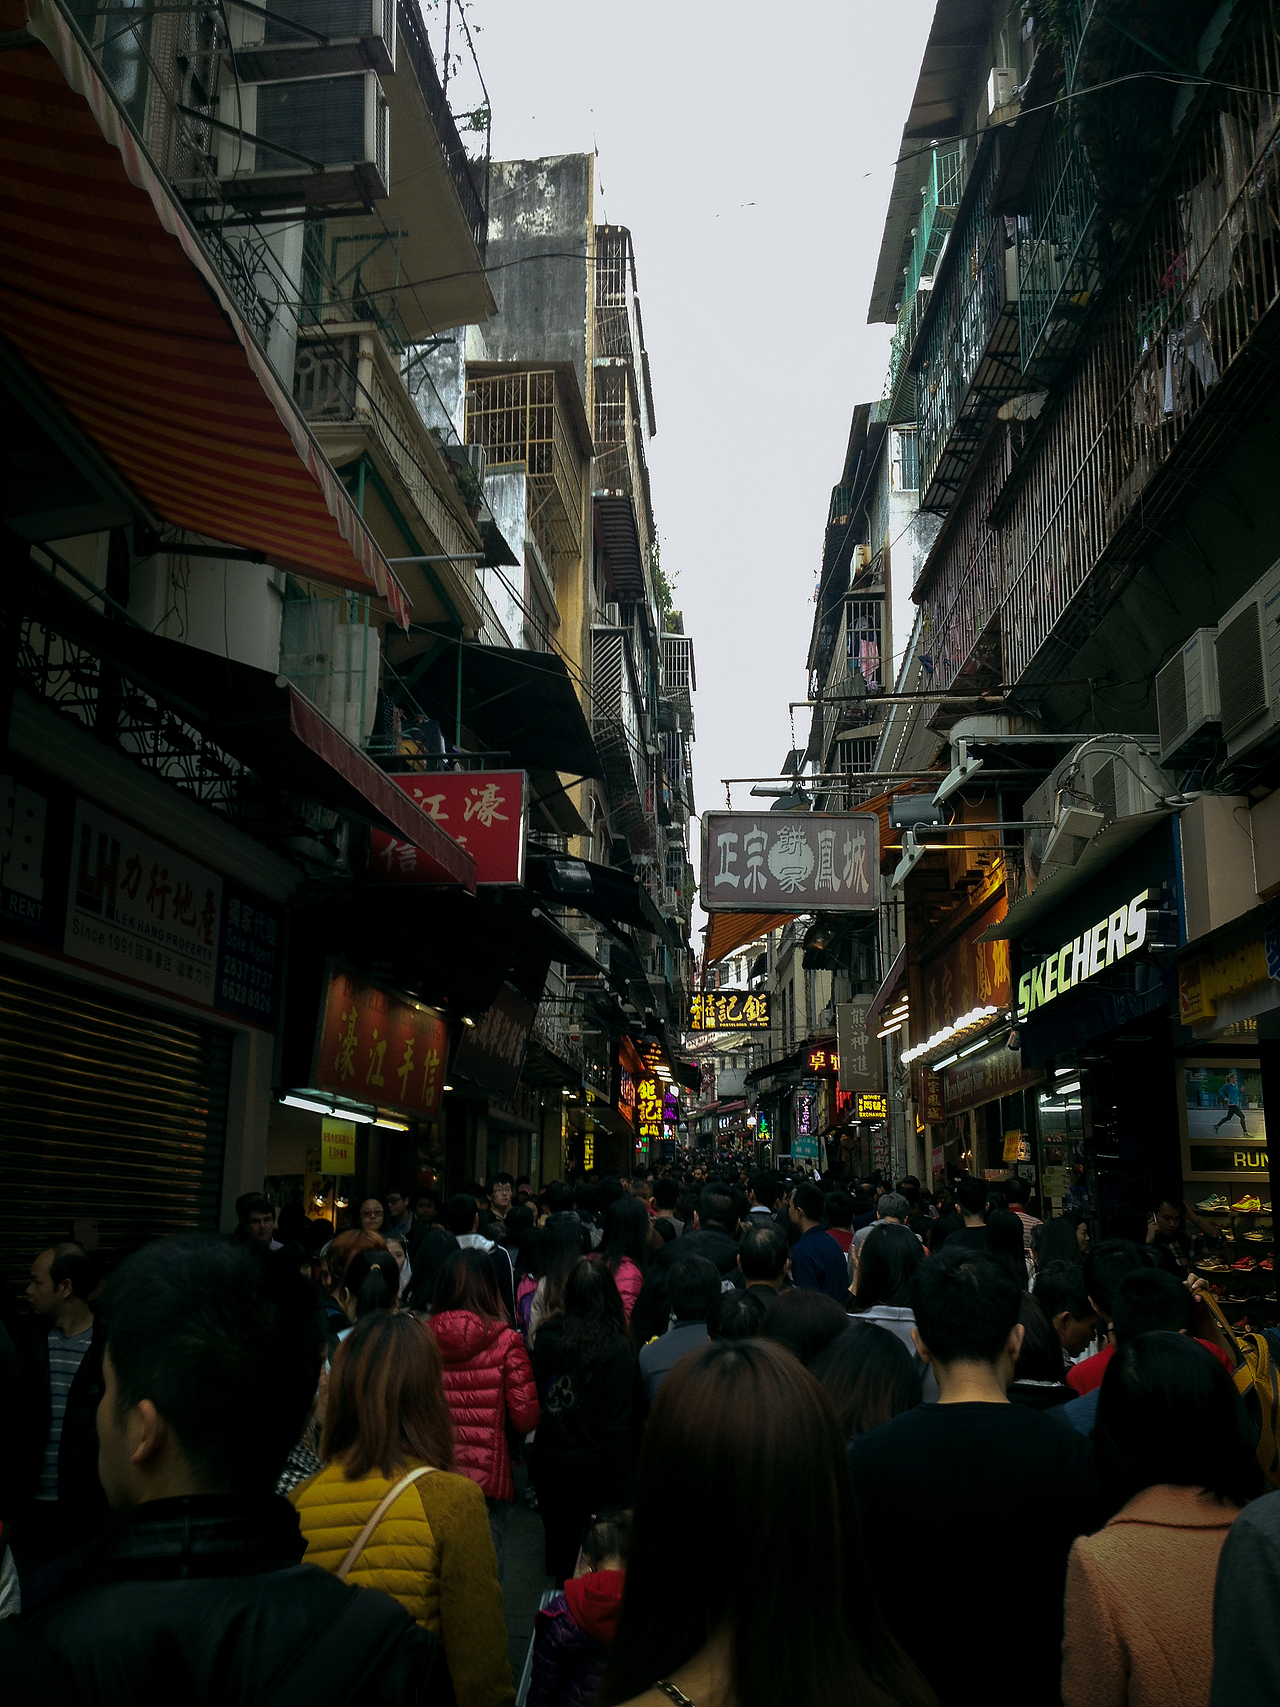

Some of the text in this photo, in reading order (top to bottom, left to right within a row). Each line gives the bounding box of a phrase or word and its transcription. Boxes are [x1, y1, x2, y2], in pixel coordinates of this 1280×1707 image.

[9, 893, 44, 921] RENT
[119, 853, 215, 946] 力行地產
[72, 918, 105, 945] Since
[108, 932, 134, 956] 1991
[115, 909, 213, 961] LEK HANG PROPERTY
[225, 927, 276, 966] Sole Agent
[1017, 887, 1149, 1018] SKECHERS
[223, 953, 274, 991] 2837 3737
[221, 977, 272, 1014] 6628 8926
[333, 1006, 440, 1107] 濠江手信
